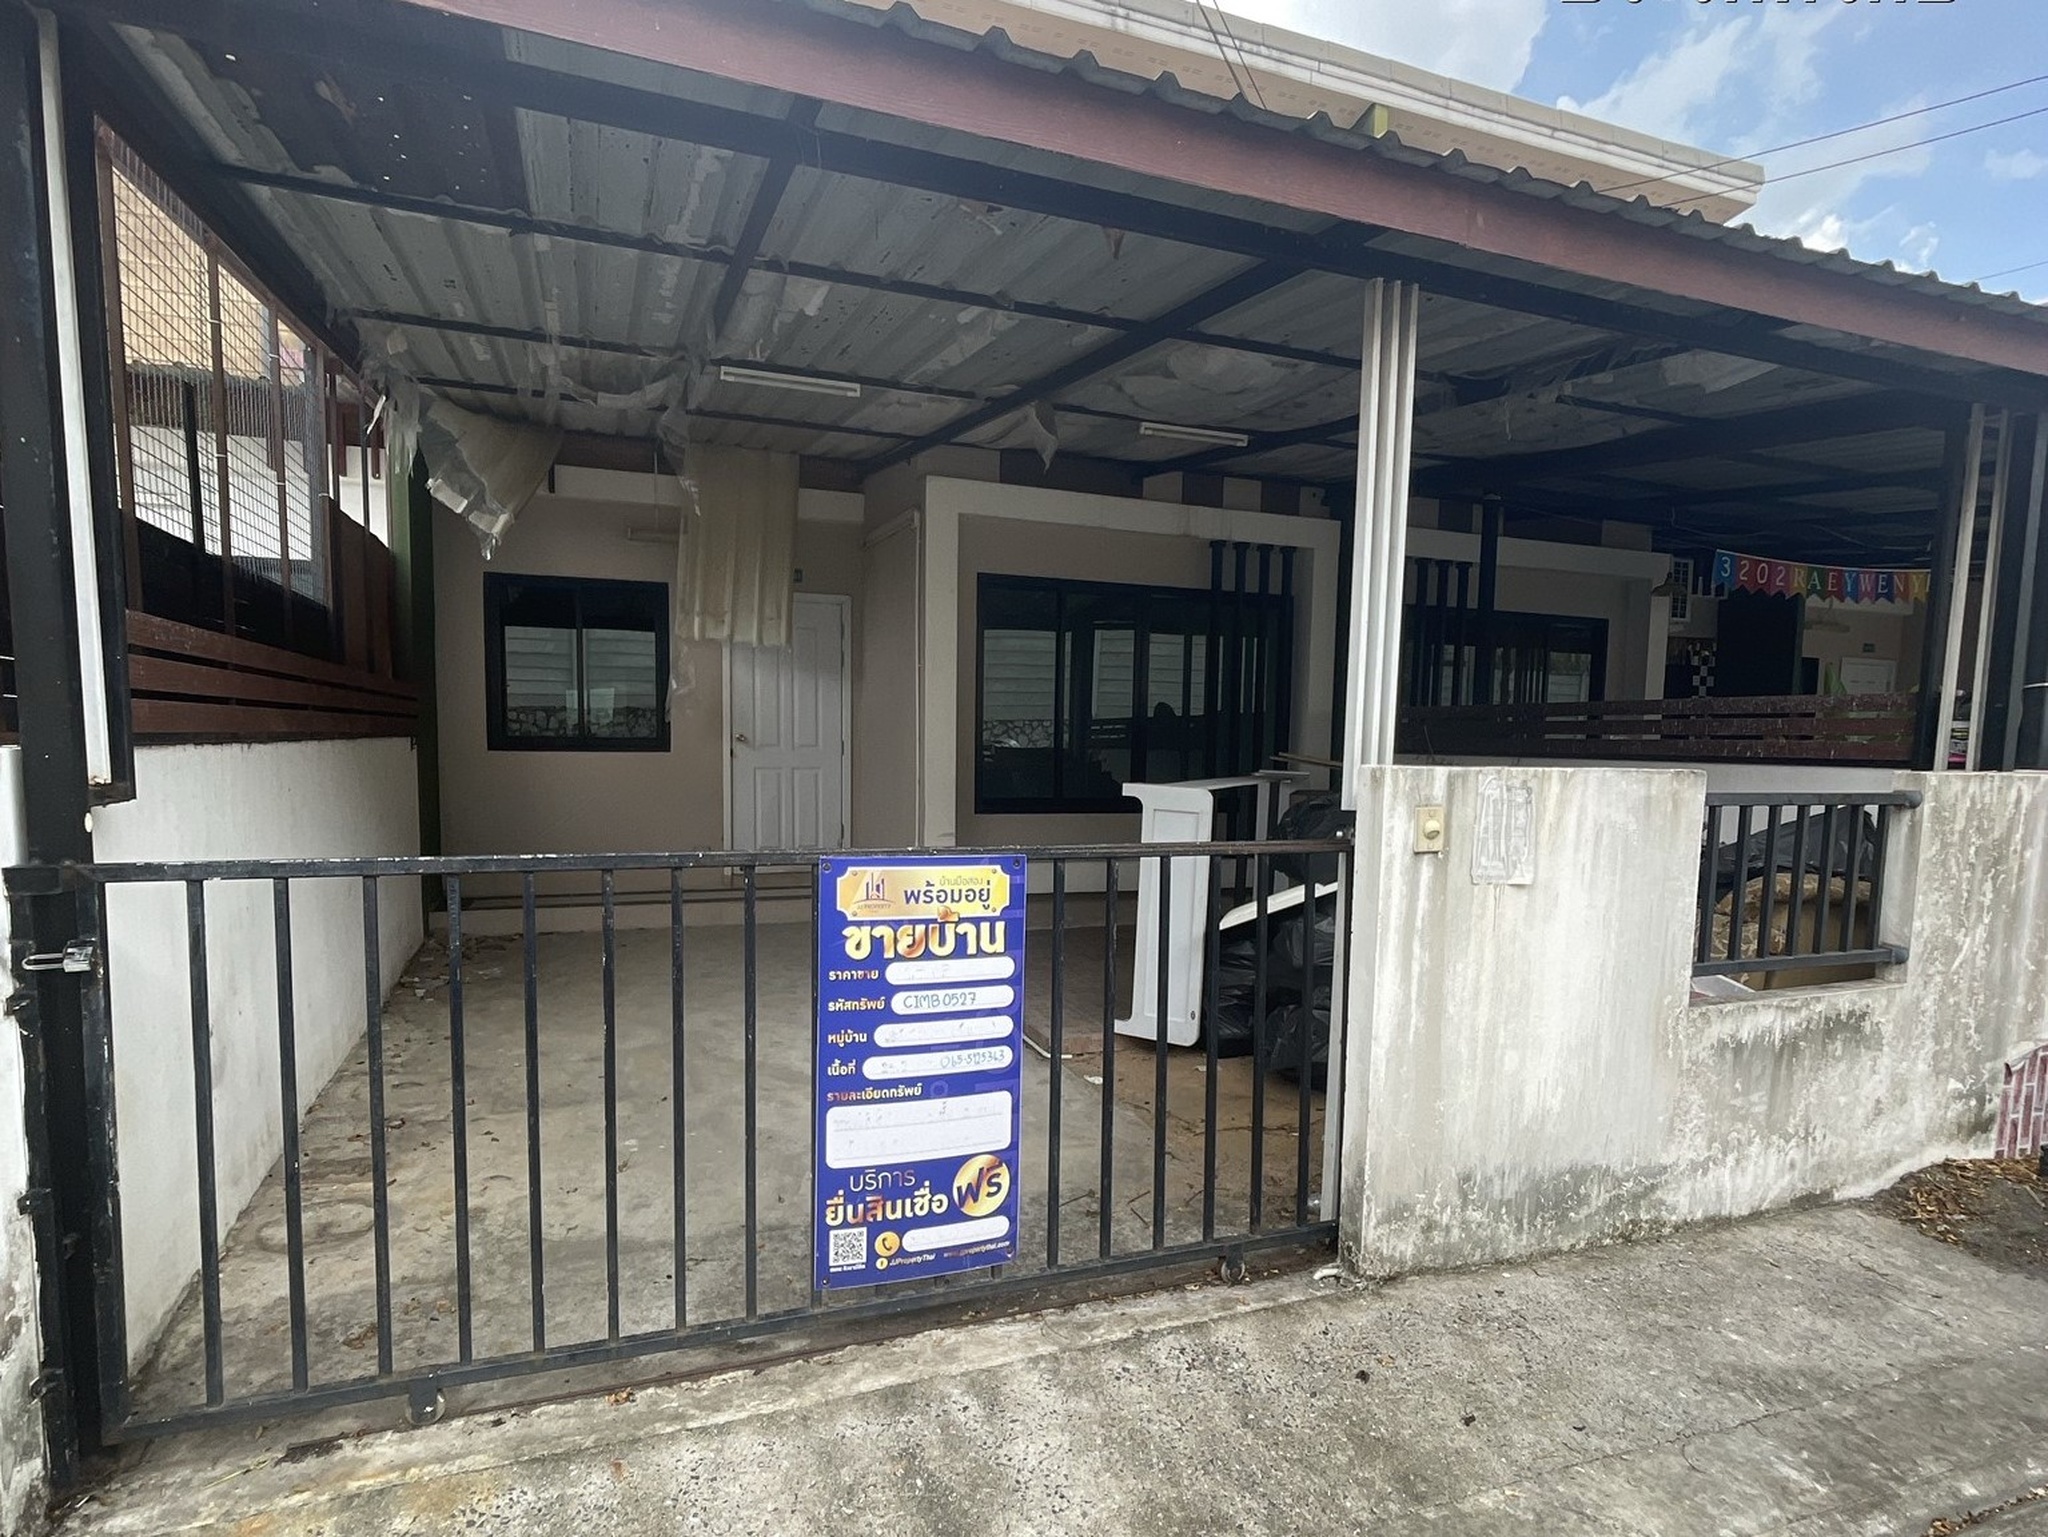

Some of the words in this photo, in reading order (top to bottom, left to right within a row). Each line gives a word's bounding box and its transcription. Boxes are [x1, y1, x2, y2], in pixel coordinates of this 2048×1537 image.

[903, 879, 991, 910] พร้อมอยู่
[842, 906, 1006, 960] ขายบ้าน
[828, 969, 879, 981] ราคาขาย
[827, 996, 886, 1012] รหัสทรัพย์
[827, 1030, 868, 1047] หมู่บ้าน
[827, 1059, 856, 1076] เนื้อที่
[827, 1083, 922, 1101] รายละเอียดทรัพย์
[850, 1168, 915, 1192] บริการ
[956, 1161, 1004, 1210] ฟรี
[825, 1181, 949, 1226] ยื่นสินเชื่อ
